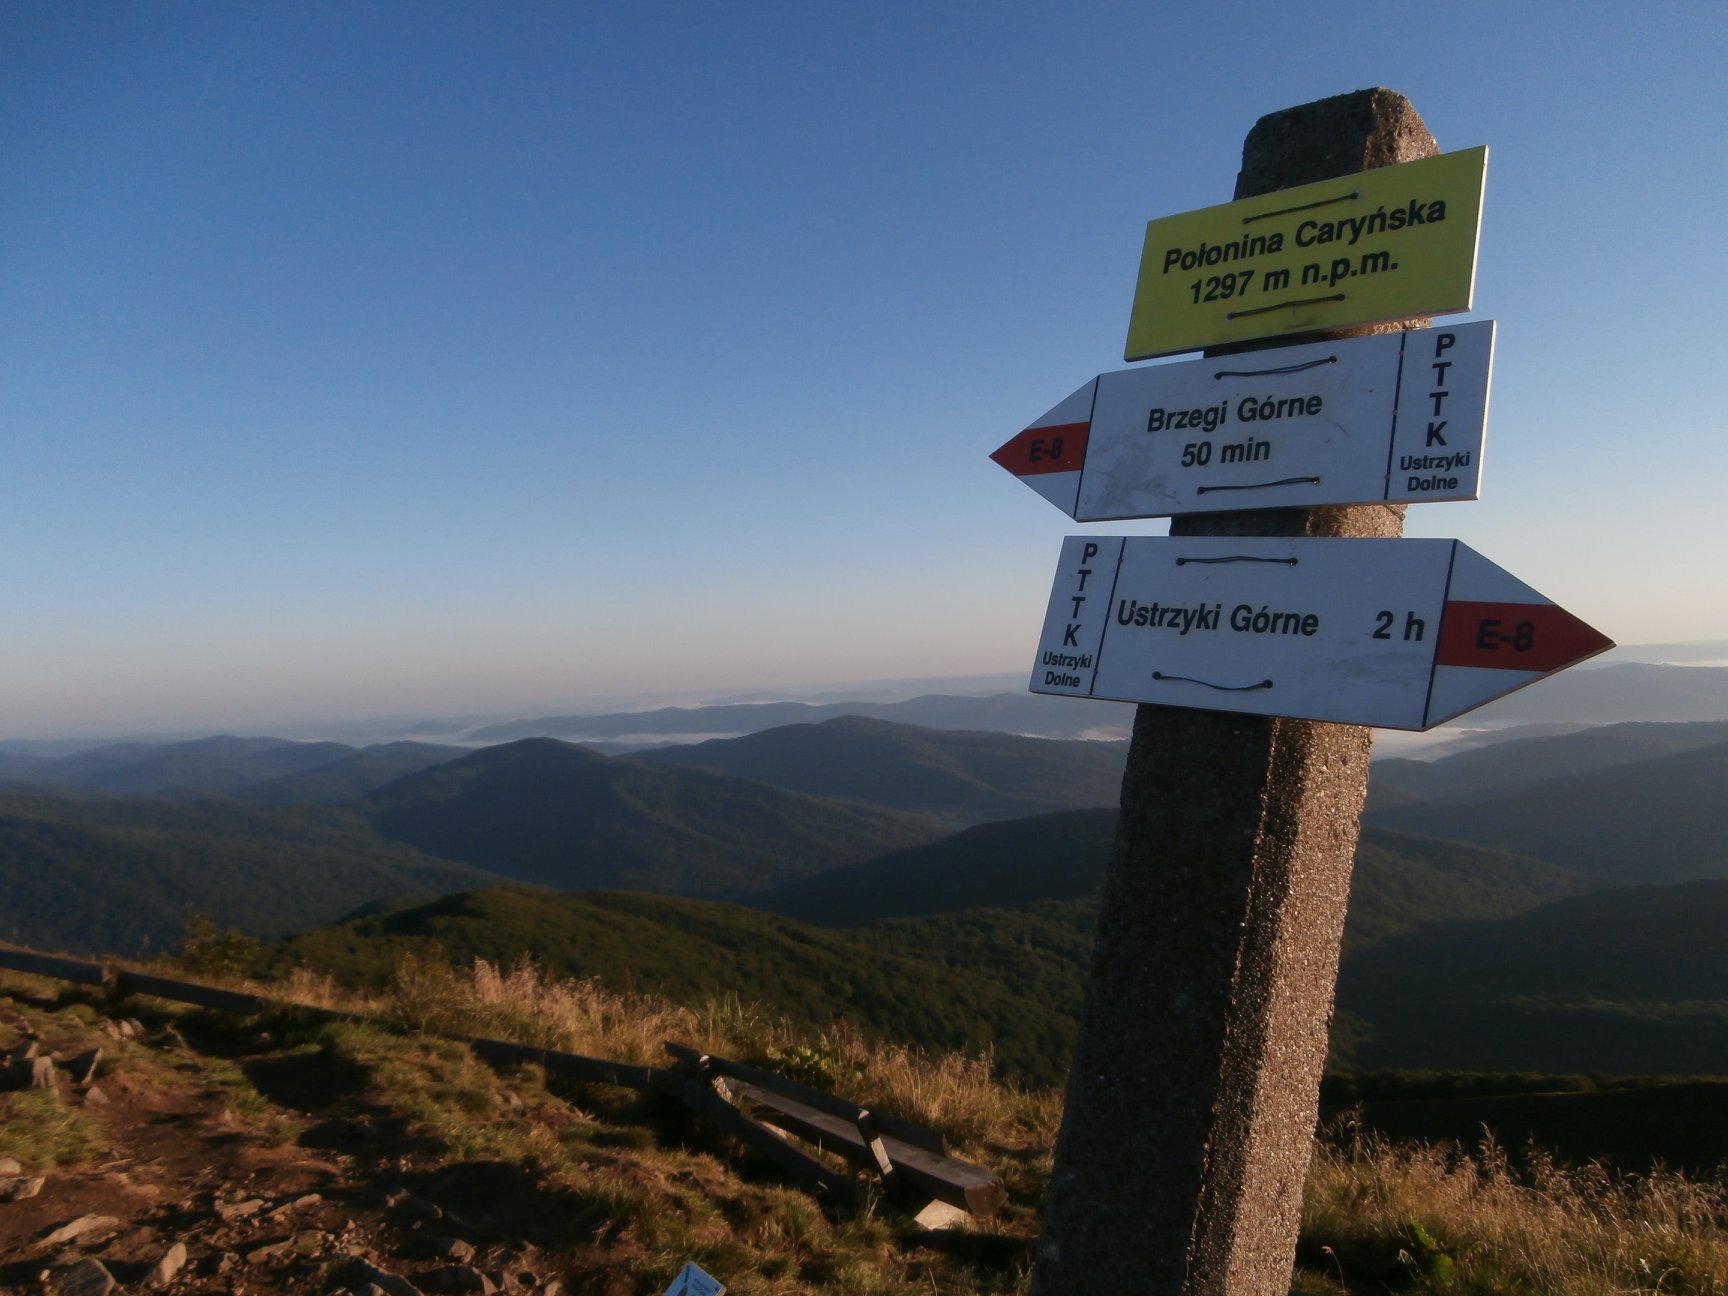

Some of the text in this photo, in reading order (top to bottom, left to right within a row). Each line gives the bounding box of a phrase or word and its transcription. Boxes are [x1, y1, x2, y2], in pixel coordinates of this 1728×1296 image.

[1162, 199, 1447, 274] Połonina Caryńska
[1190, 250, 1399, 304] 1297 m n.p.m.
[1425, 333, 1456, 447] PTTK
[1147, 392, 1323, 432] Brzegi Górne
[1028, 437, 1063, 462] E-8
[1180, 436, 1271, 468] 50 min
[1400, 450, 1471, 473] Ustrzyki
[1407, 473, 1459, 492] Dolne
[1063, 543, 1099, 648] PTTK
[1117, 600, 1426, 641] Ustrzyki Górne 2 h
[1476, 618, 1535, 652] E-8
[1042, 651, 1092, 670] Ustrzyki
[1045, 671, 1081, 688] Dolne
